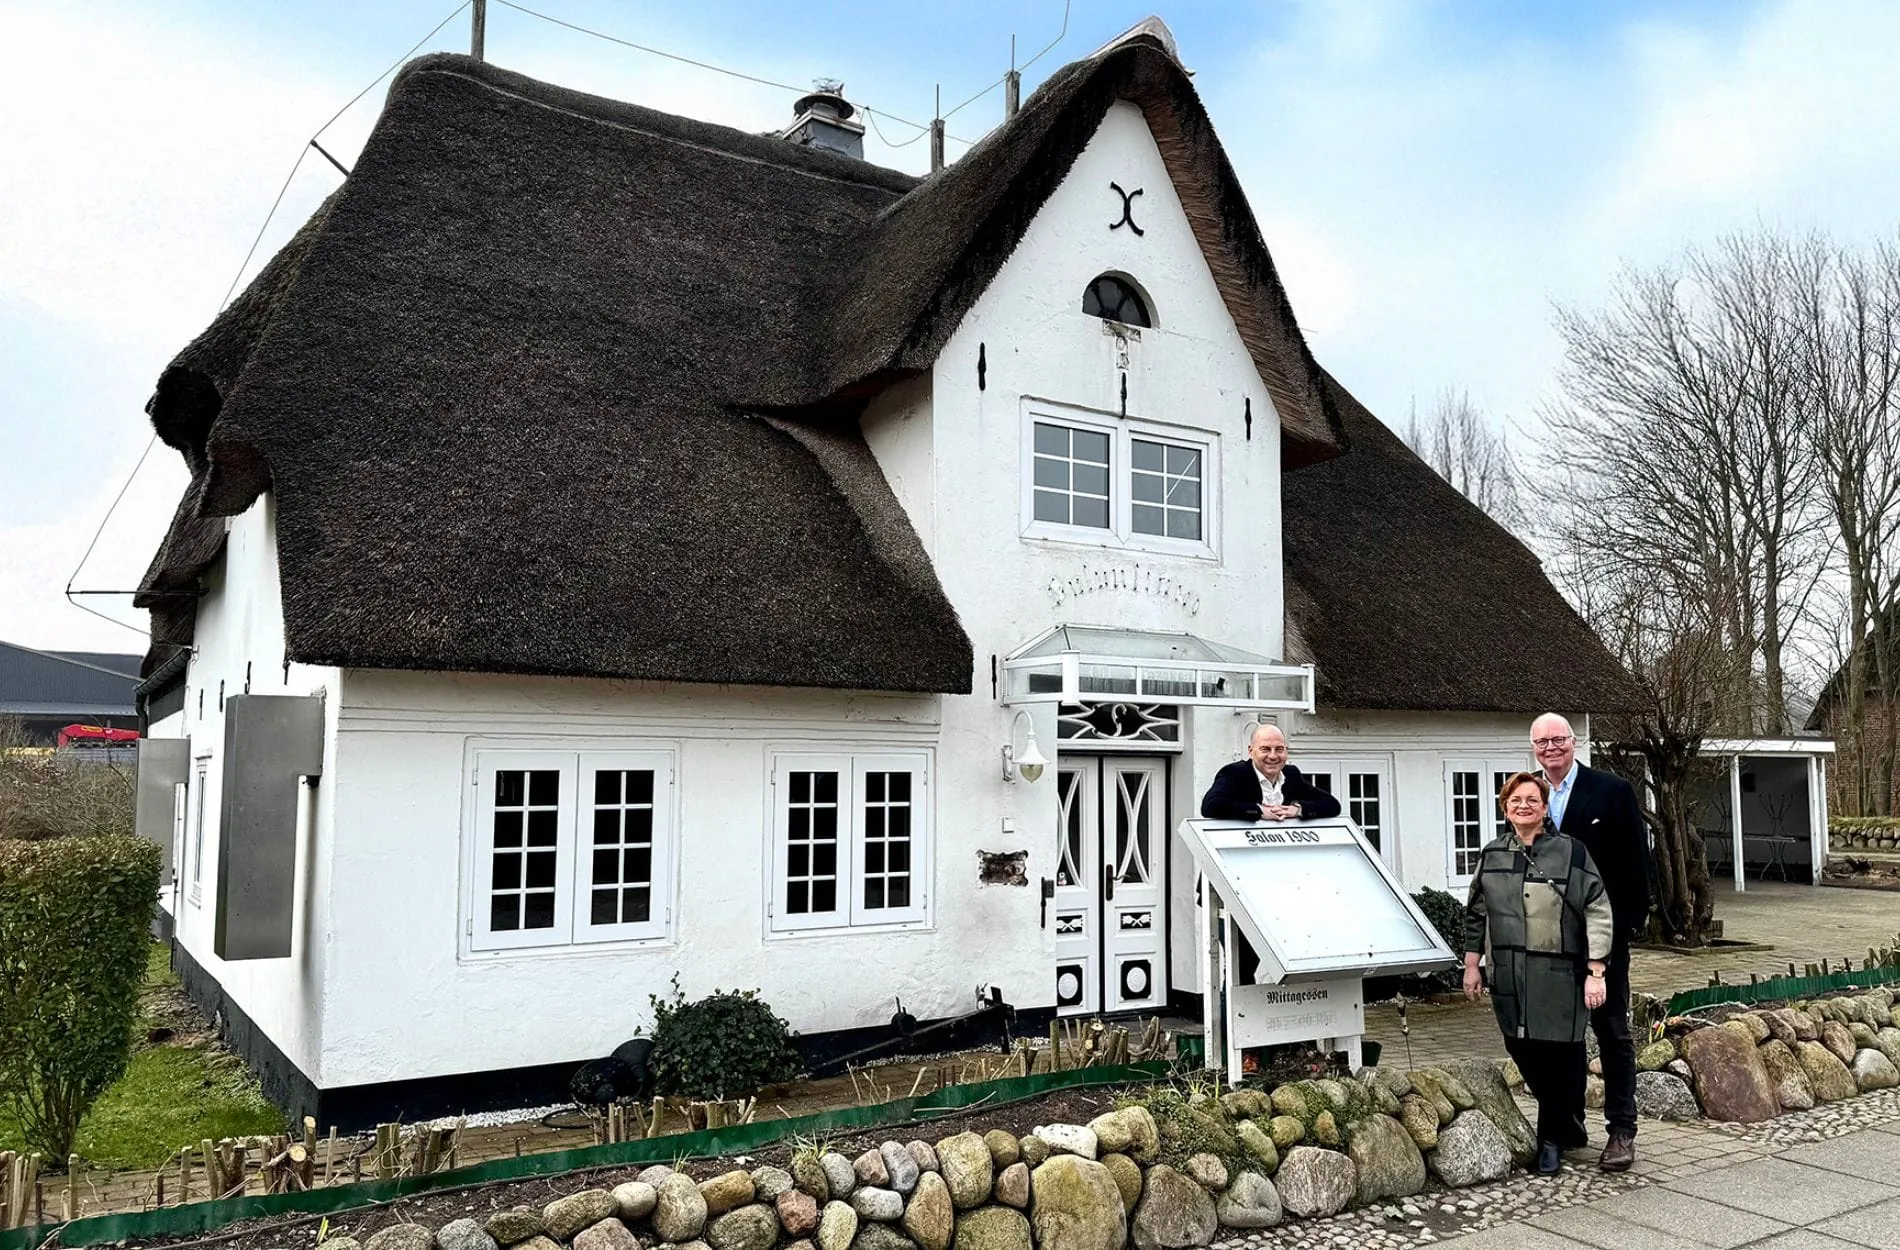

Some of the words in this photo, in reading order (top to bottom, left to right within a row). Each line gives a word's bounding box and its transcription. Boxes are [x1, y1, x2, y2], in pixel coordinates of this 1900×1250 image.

[1245, 831, 1285, 846] Salon
[1285, 830, 1320, 843] 1900
[1266, 988, 1328, 1005] Mittagessen
